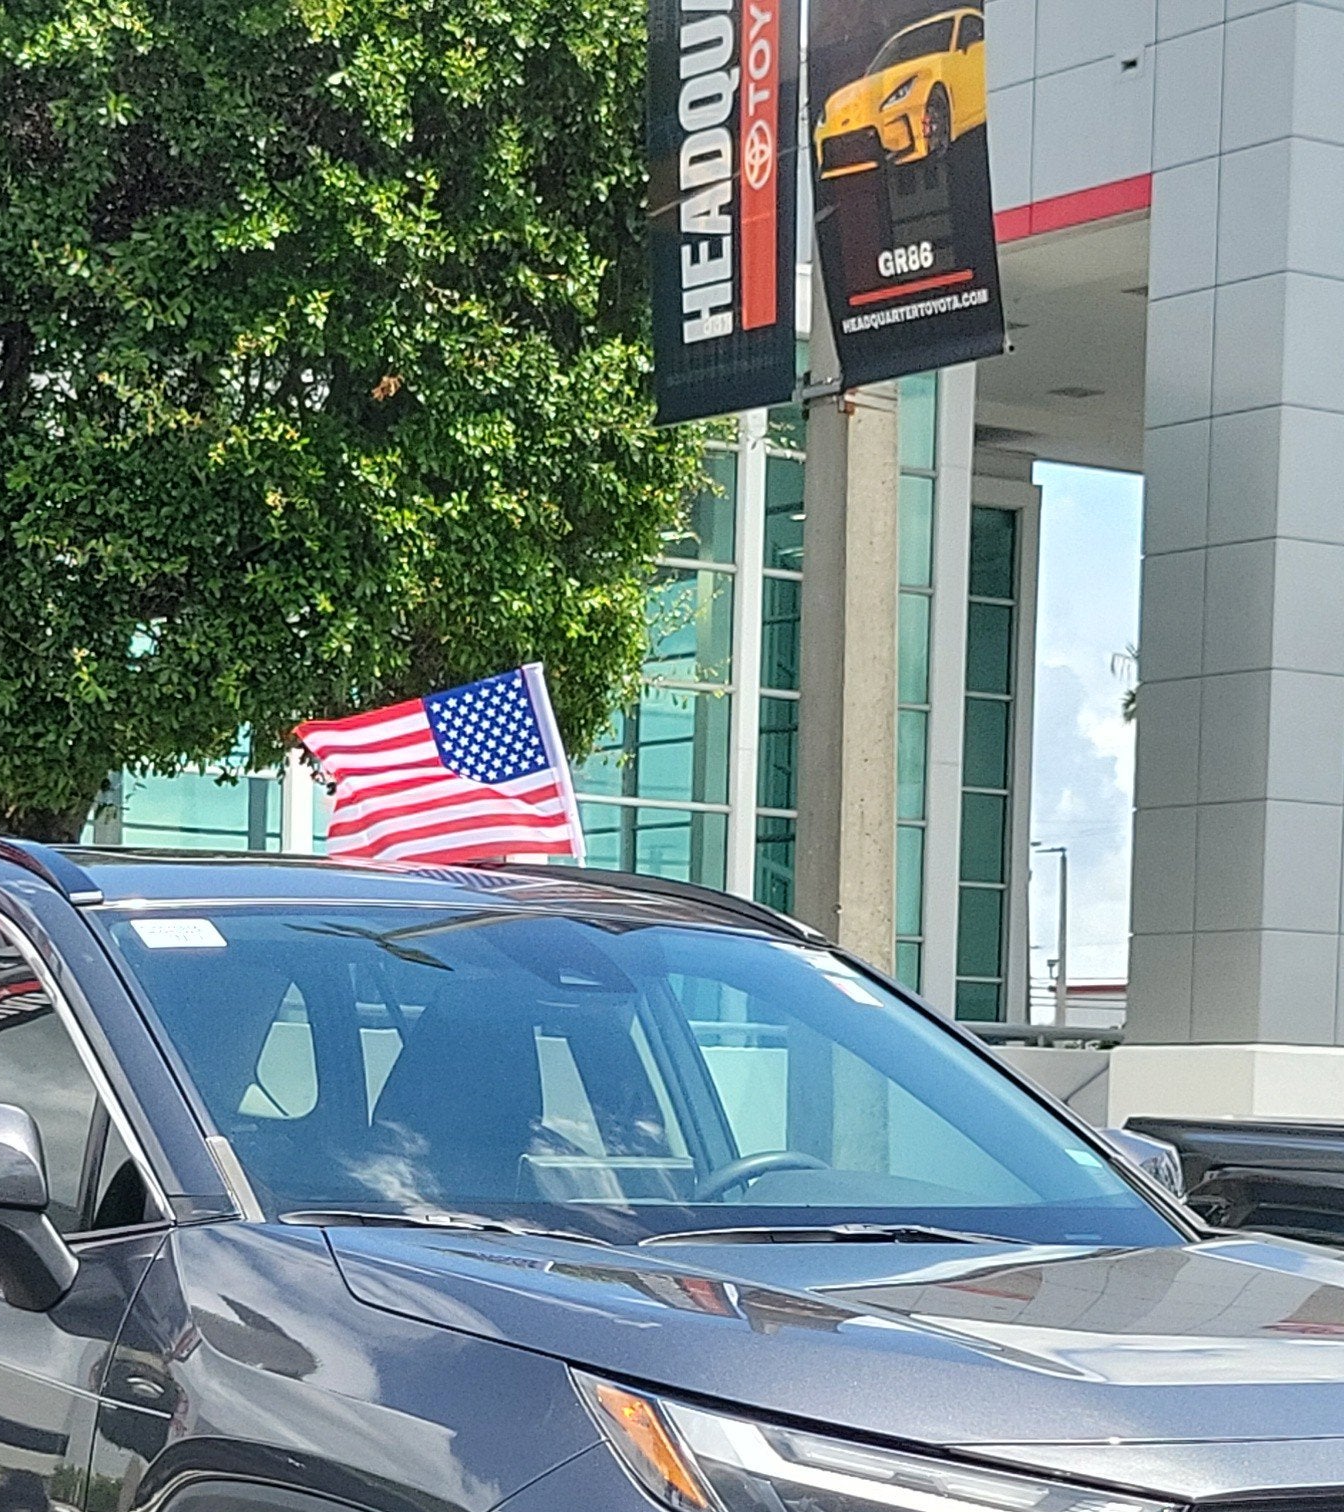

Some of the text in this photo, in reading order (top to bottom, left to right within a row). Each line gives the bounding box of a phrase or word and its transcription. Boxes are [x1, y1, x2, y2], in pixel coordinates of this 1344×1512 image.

[678, 0, 740, 344] HEADQU
[877, 241, 934, 278] GR86
[841, 288, 990, 335] HEADQUARTERTOYOTA.COM
